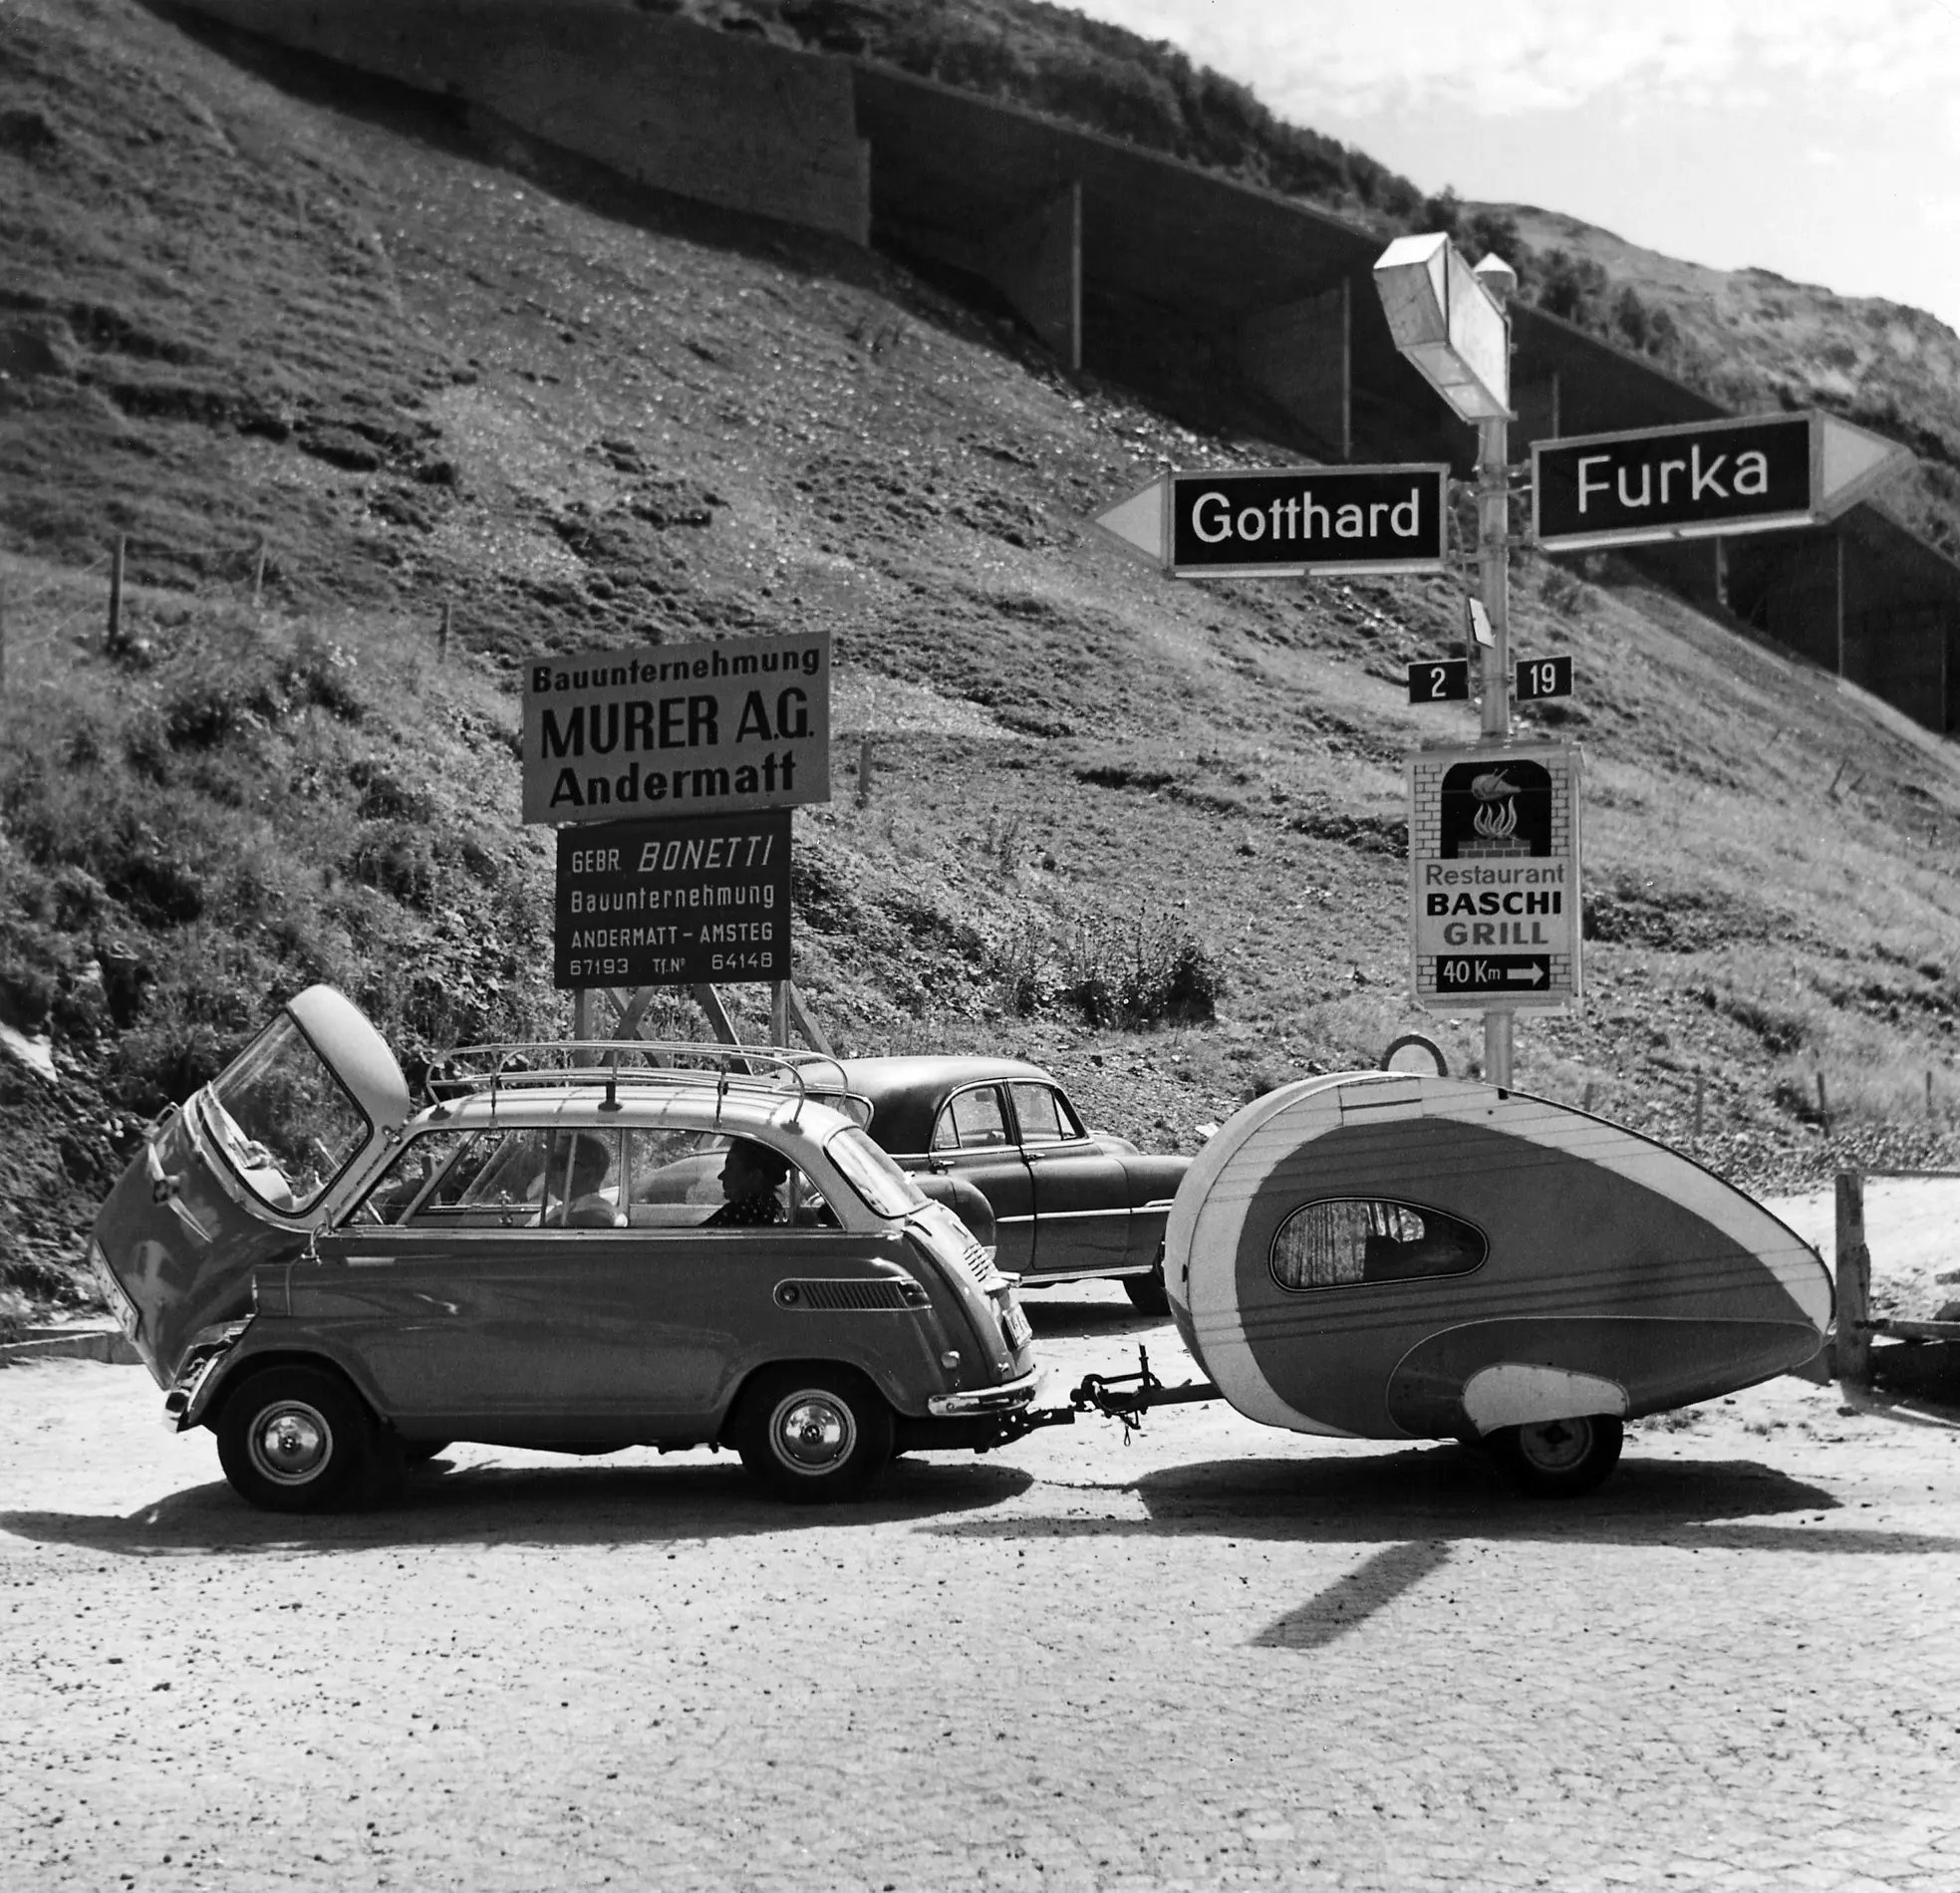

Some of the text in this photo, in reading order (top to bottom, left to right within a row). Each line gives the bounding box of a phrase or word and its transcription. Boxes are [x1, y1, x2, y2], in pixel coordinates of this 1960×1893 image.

[1578, 443, 1768, 514] Furka
[1192, 488, 1420, 543] Gotthard
[532, 649, 820, 692] Bauunternehmung
[1431, 667, 1447, 697] 2
[1530, 663, 1556, 694] 19
[541, 687, 815, 759] MURER A.G.
[549, 750, 796, 808] Andermatt
[638, 835, 774, 872] BONETTI
[1426, 864, 1564, 886] Restaurant
[571, 885, 774, 914] Bauunternehmung
[1427, 891, 1561, 916] BASCHI
[572, 926, 678, 947] ANDERMATT
[700, 923, 773, 944] AMSTEG
[1444, 922, 1549, 946] GRILL
[570, 958, 629, 975] 67193
[711, 951, 773, 970] 64148
[1443, 960, 1501, 983] 40 Km
